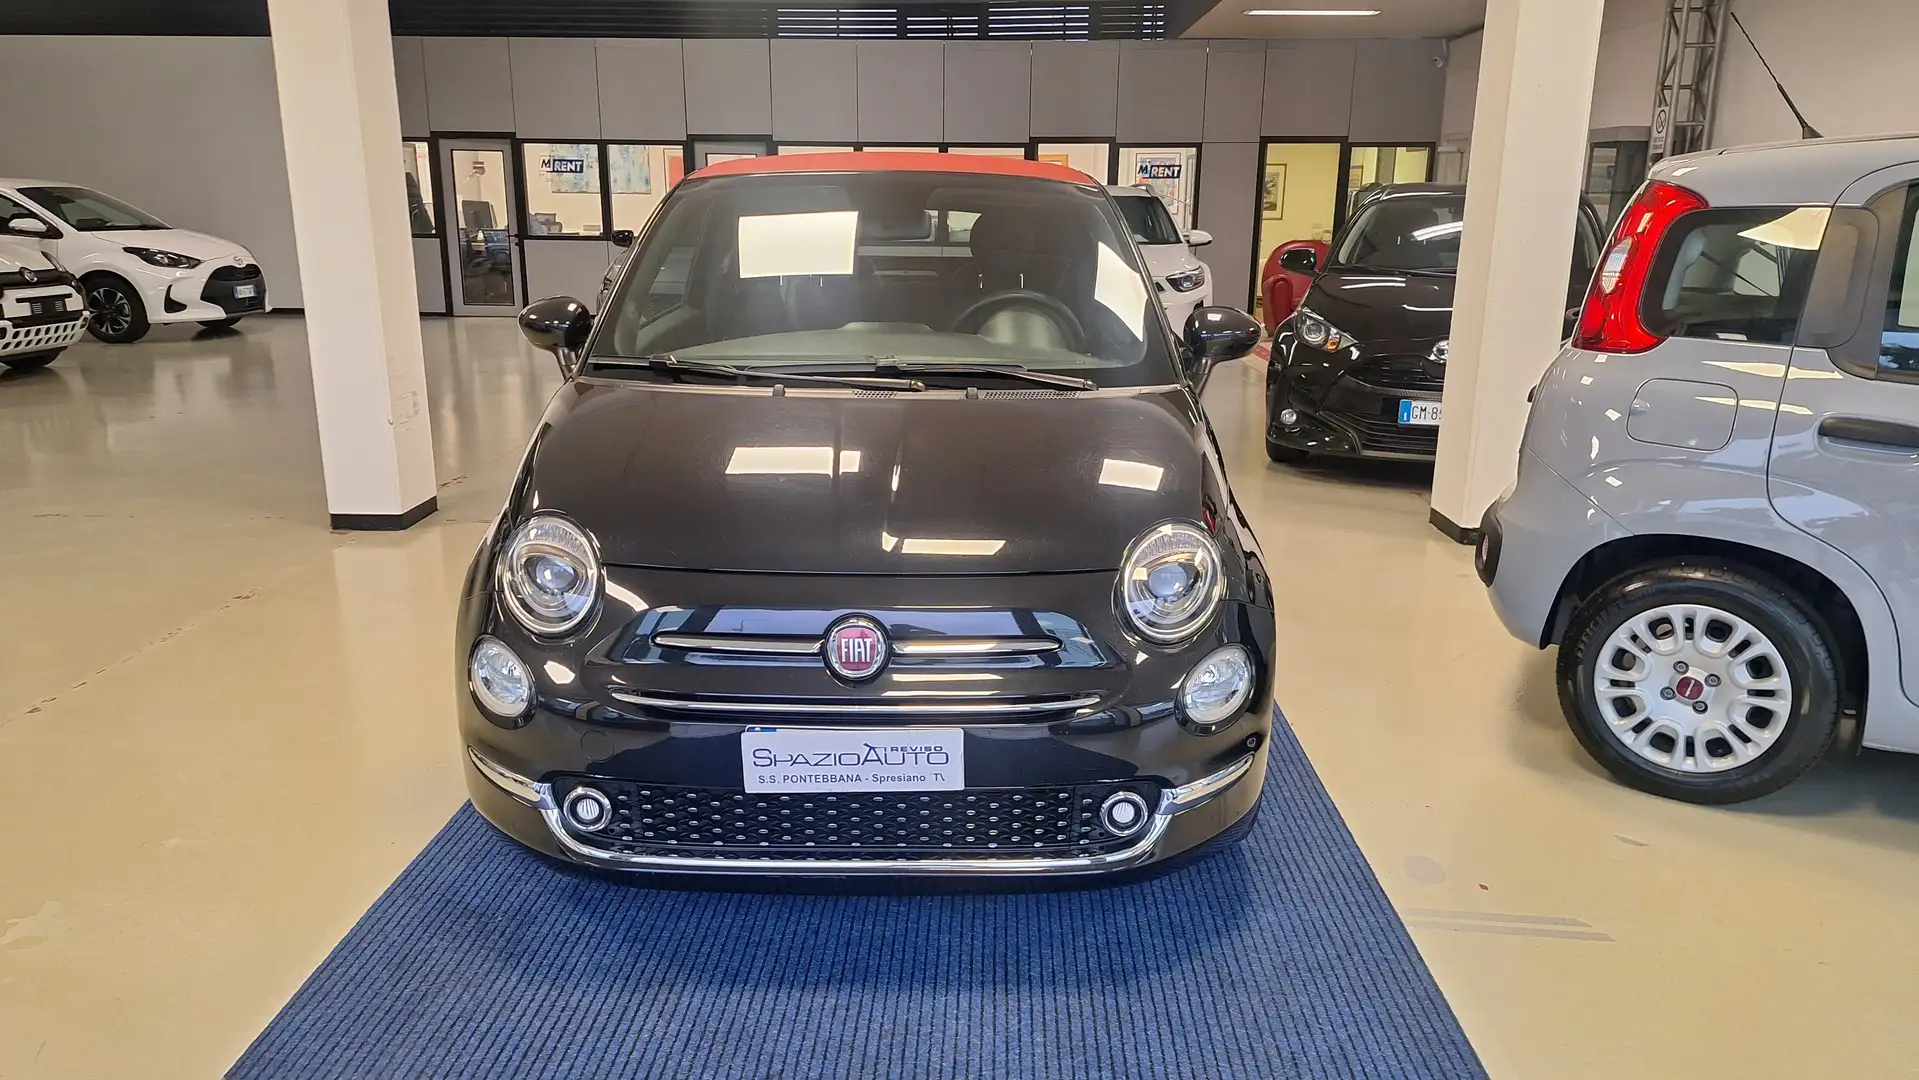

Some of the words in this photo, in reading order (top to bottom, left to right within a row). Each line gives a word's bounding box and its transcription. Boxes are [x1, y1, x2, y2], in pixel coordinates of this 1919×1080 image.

[554, 161, 582, 172] RENT
[1152, 167, 1180, 177] RENT
[841, 637, 873, 663] FIAT
[758, 774, 780, 784] S.S.
[783, 774, 863, 784] PONTEBBANA
[871, 773, 926, 785] Spresiano
